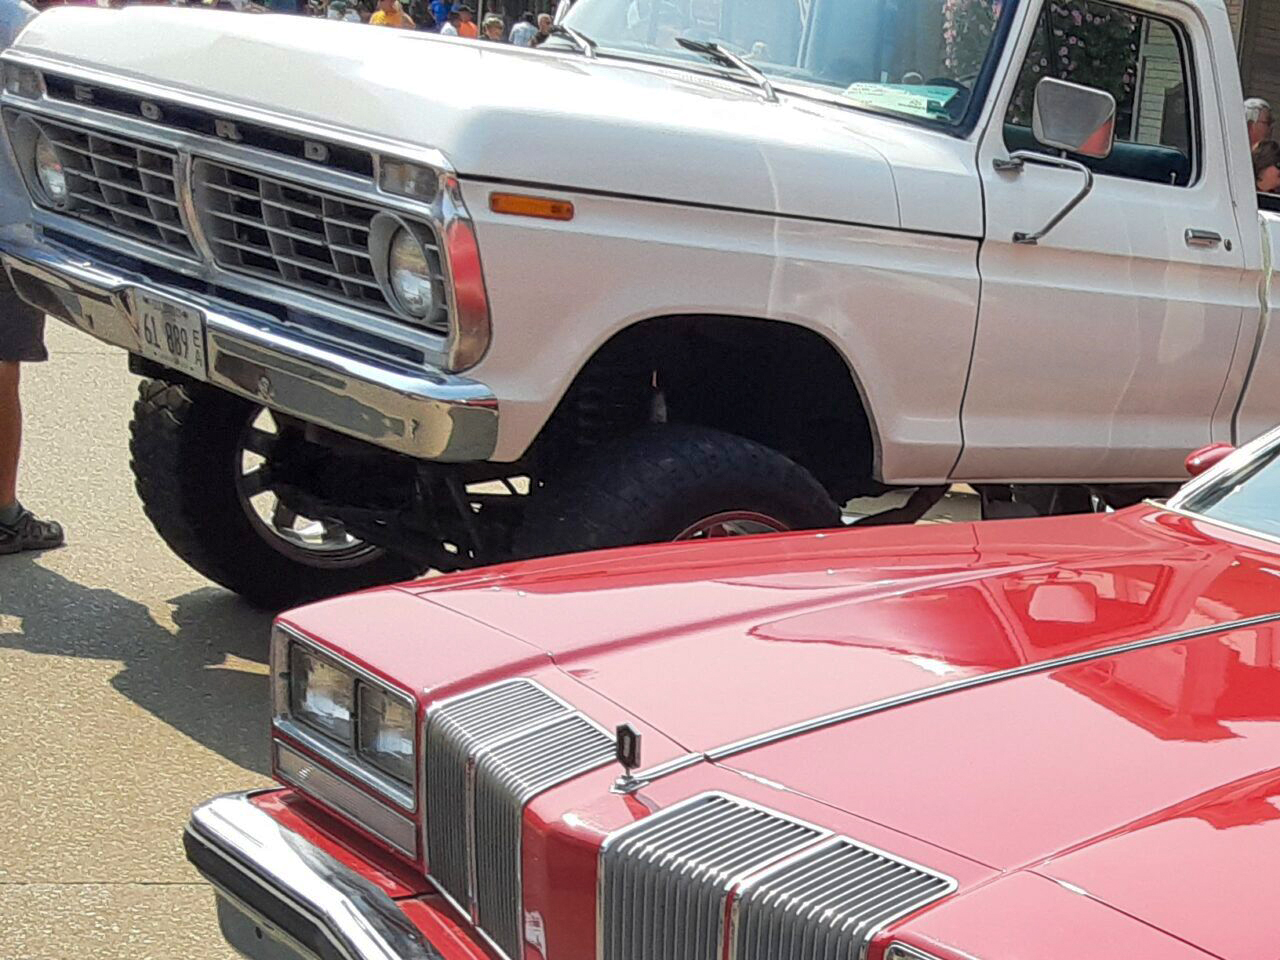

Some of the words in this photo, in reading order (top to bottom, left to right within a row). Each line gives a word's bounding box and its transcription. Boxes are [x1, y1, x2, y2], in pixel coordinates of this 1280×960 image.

[74, 84, 330, 163] FORD
[144, 313, 161, 349] 61
[165, 321, 189, 359] 889
